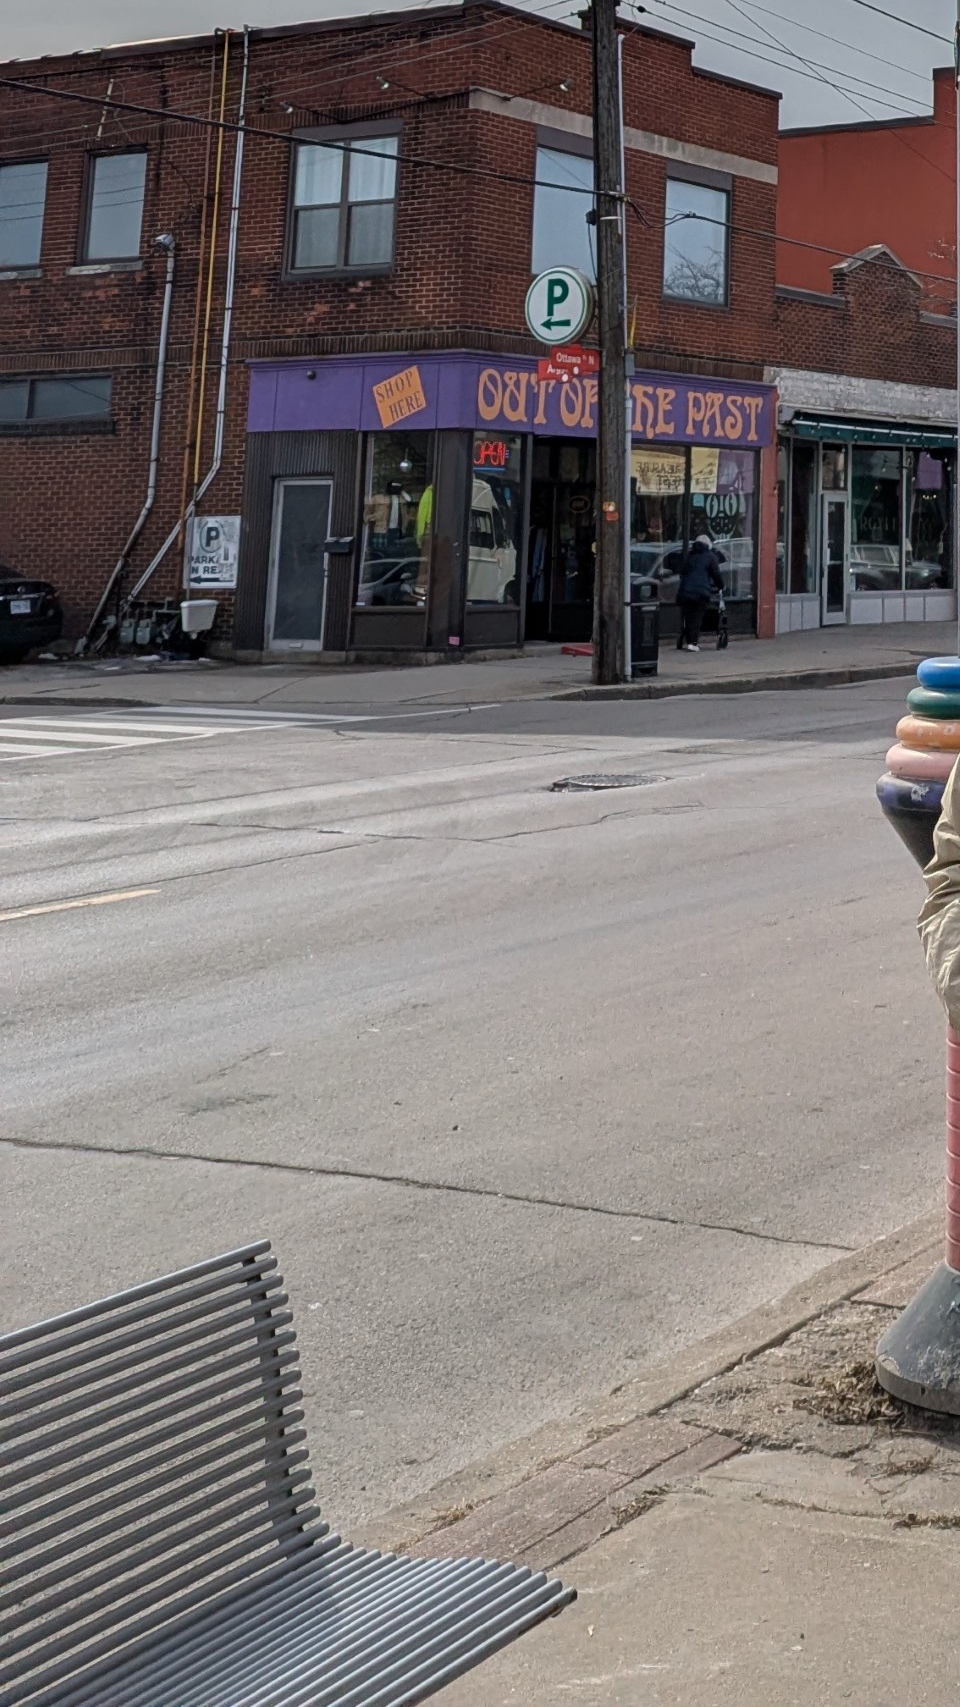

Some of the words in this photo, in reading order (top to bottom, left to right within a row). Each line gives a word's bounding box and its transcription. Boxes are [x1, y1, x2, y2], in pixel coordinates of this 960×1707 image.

[547, 277, 569, 317] P
[555, 352, 581, 364] Ottawa
[588, 355, 595, 365] N
[375, 370, 412, 403] SHOP
[389, 390, 423, 421] HERE
[477, 368, 555, 425] OUT
[631, 385, 676, 439] HE
[686, 391, 763, 441] PAST
[473, 440, 506, 466] OPEN
[205, 526, 220, 547] P
